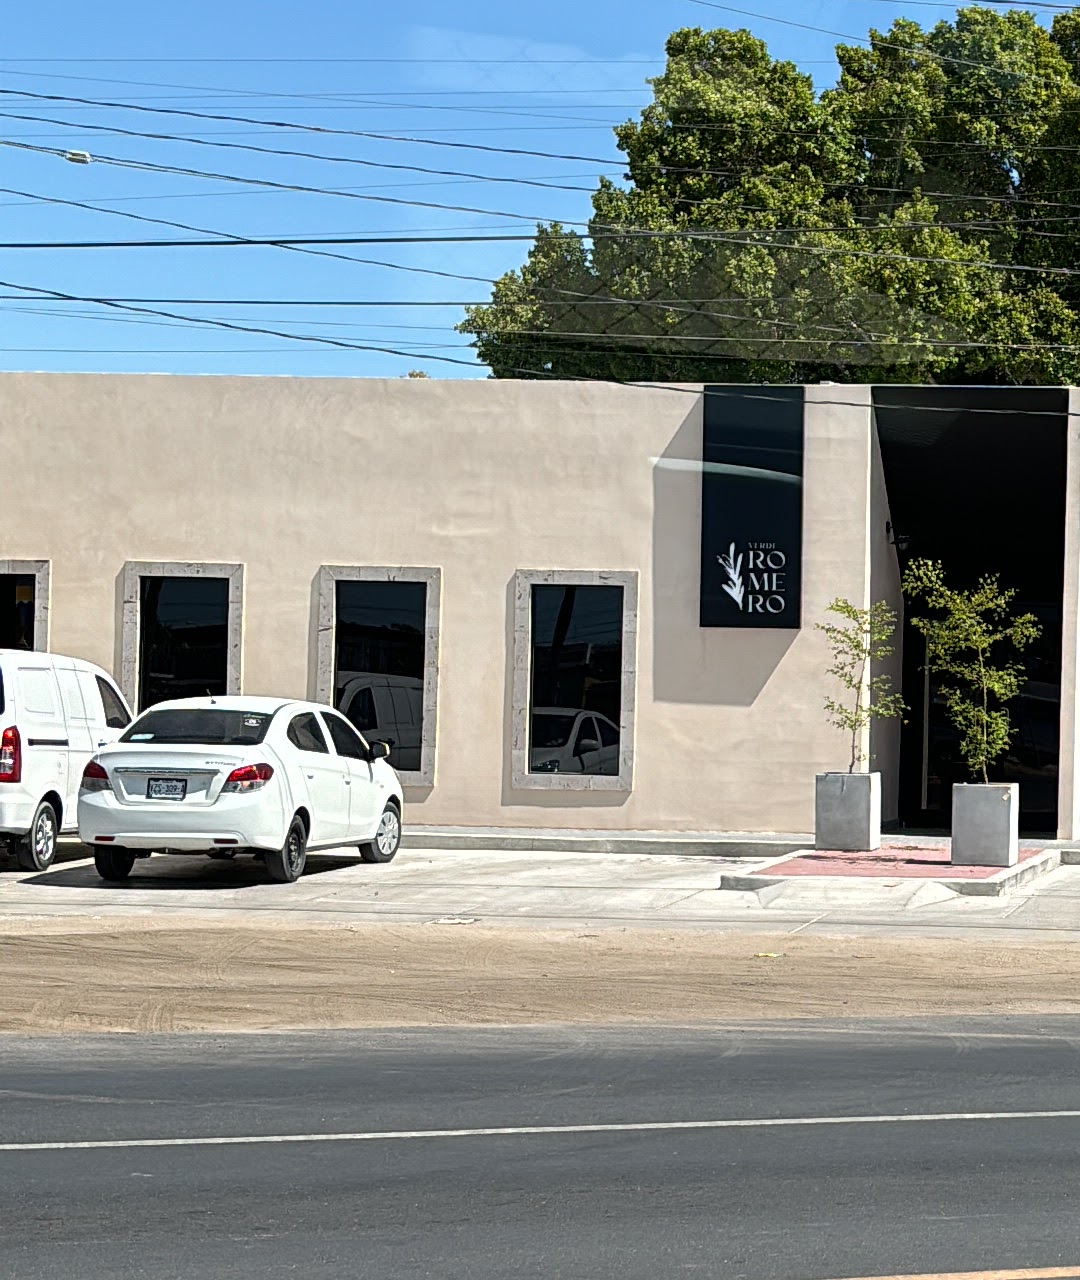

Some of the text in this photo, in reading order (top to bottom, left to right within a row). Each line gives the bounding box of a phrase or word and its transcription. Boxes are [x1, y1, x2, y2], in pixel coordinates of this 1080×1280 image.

[748, 550, 786, 569] RO
[748, 572, 786, 592] ME
[747, 594, 786, 614] RO
